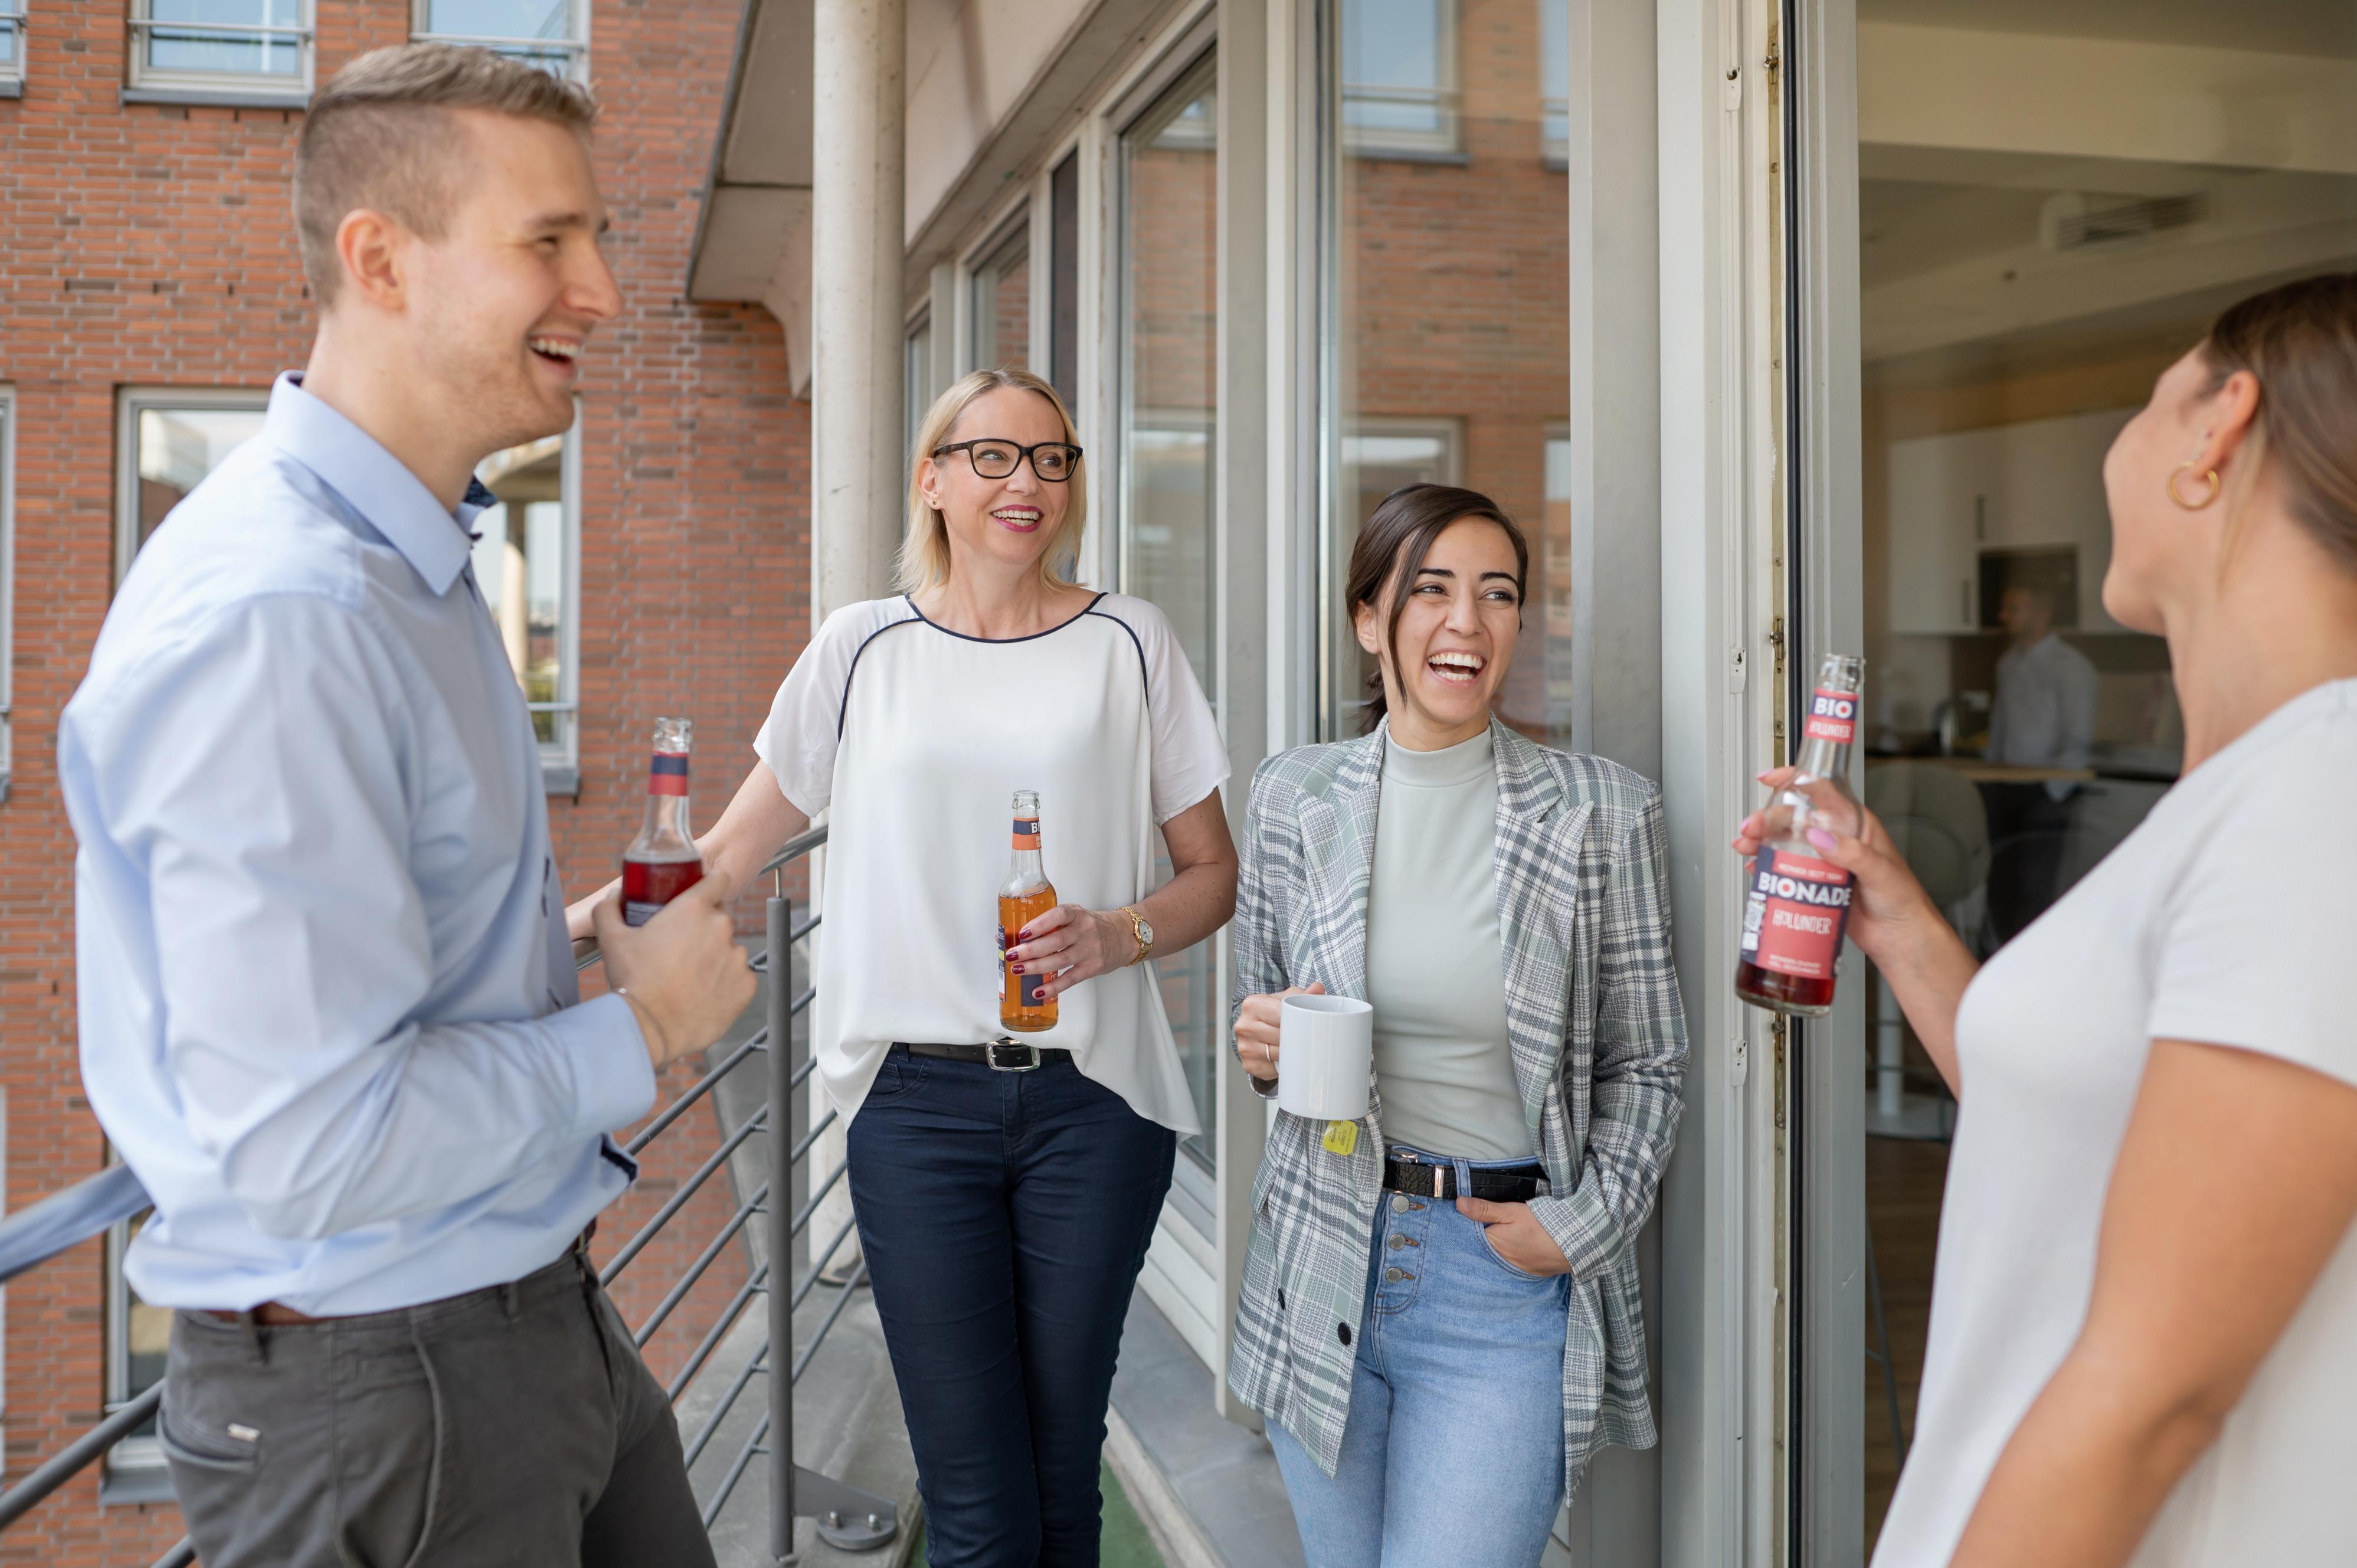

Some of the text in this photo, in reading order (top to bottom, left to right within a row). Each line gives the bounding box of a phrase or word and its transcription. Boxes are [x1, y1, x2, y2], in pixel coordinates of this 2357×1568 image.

[1813, 697, 1853, 719] BIO
[1757, 871, 1852, 906] BIONADE
[1772, 908, 1832, 935] HOLUNDER
